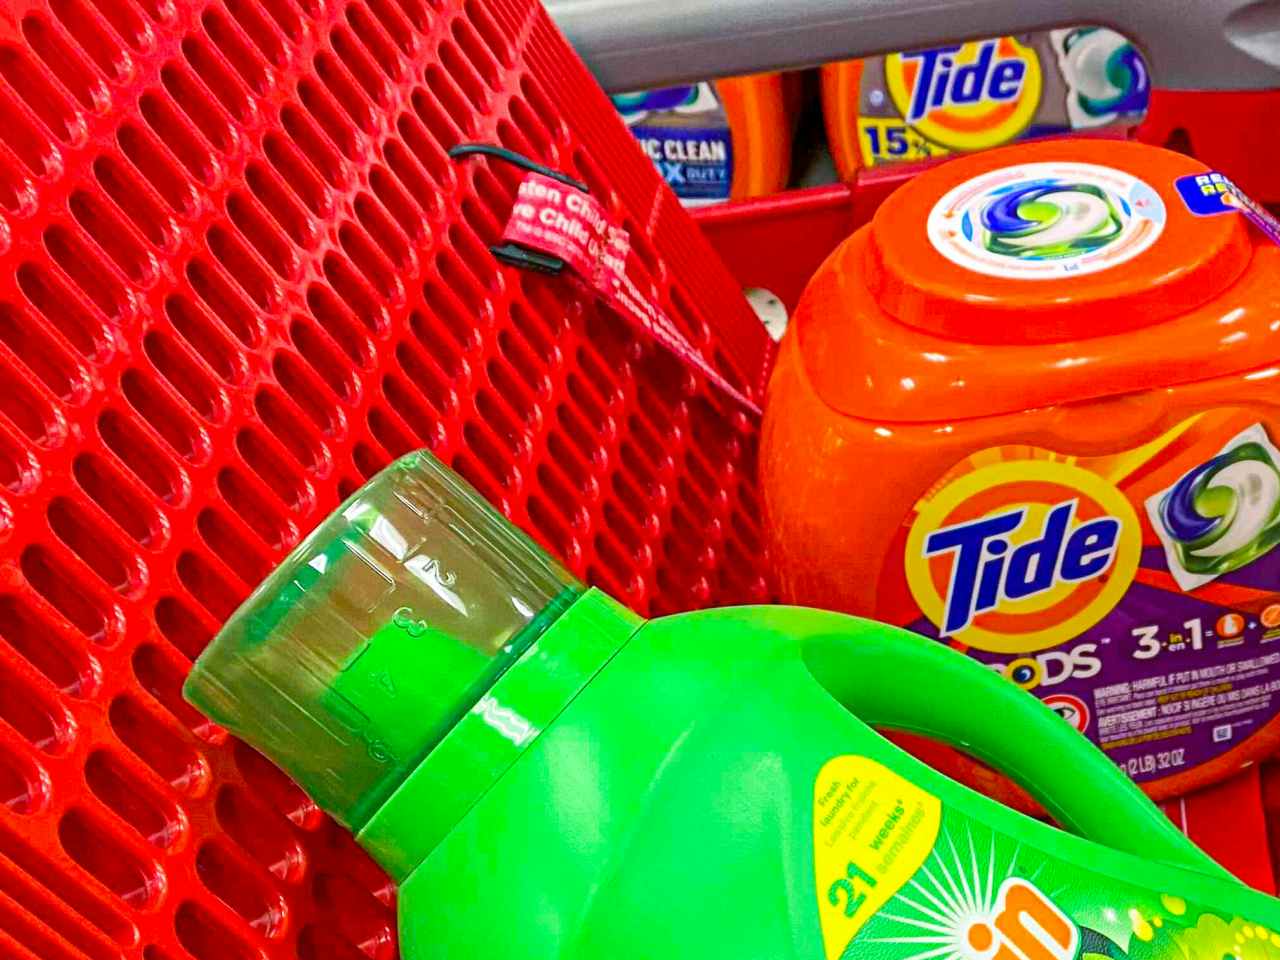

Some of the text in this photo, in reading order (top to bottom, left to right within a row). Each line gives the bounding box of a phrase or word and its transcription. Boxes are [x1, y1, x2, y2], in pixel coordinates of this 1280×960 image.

[901, 41, 1026, 123] Tide
[664, 140, 726, 161] CLEAN
[922, 498, 1121, 637] Tide
[985, 643, 1102, 690] ODS
[1156, 751, 1170, 769] 32
[1171, 748, 1185, 766] OZ
[827, 861, 878, 920] 21
